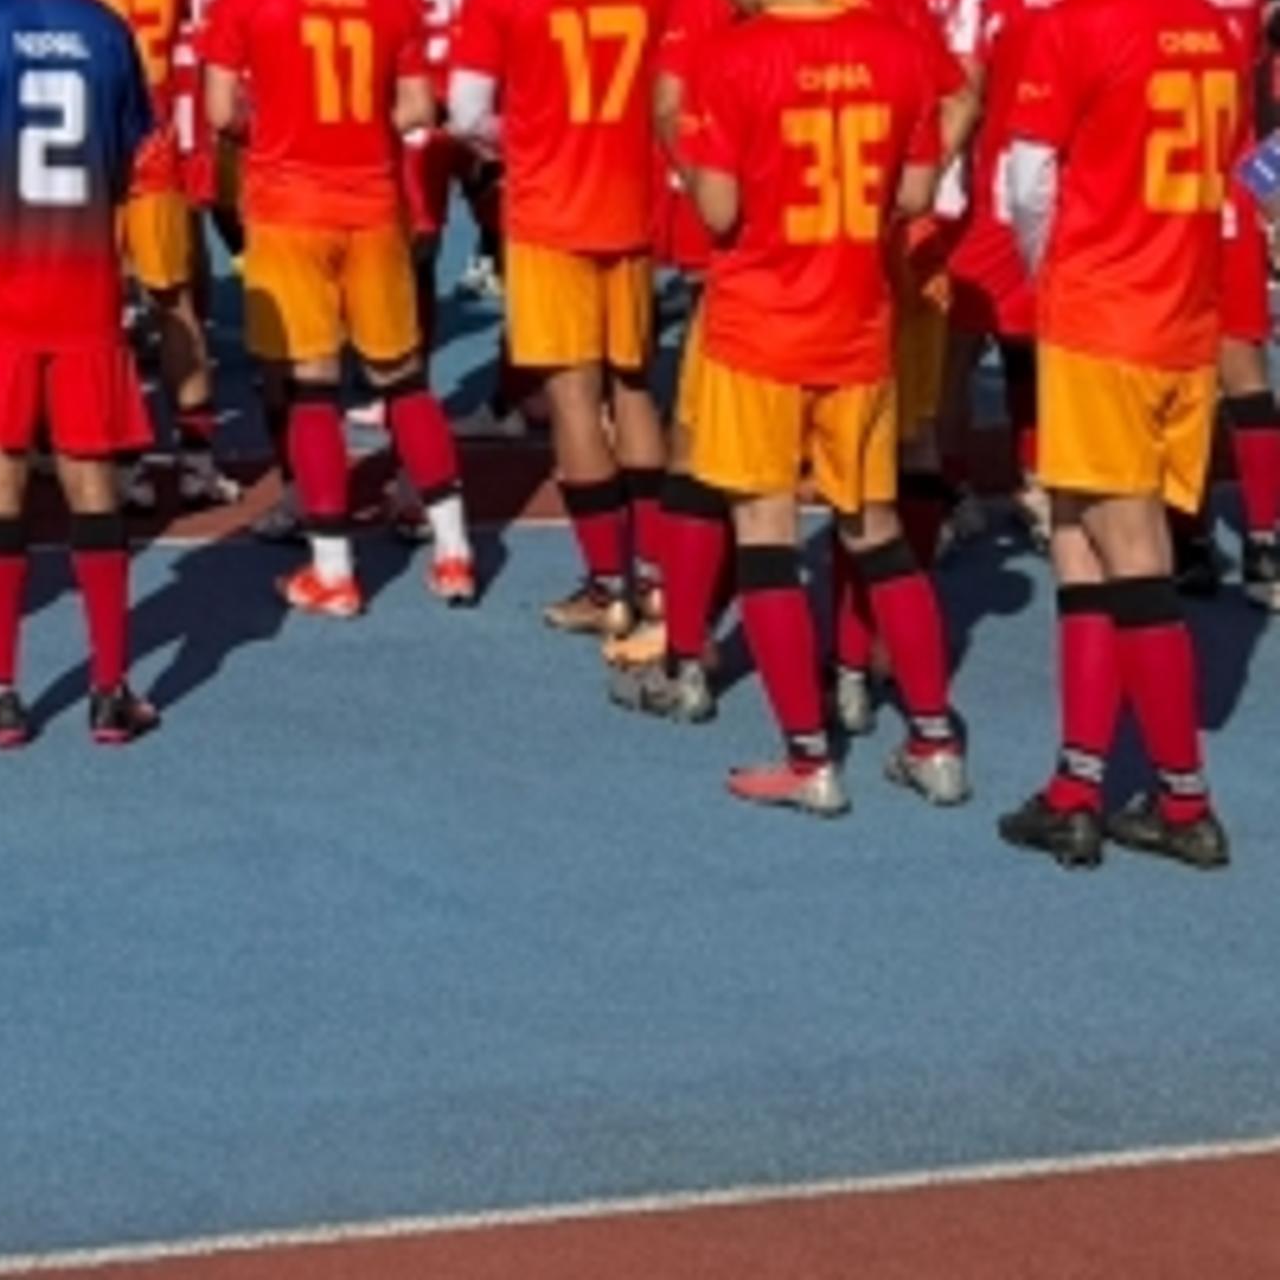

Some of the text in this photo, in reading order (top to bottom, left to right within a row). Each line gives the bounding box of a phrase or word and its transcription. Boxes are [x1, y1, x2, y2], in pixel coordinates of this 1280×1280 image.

[301, 15, 373, 124] 11
[549, 5, 648, 124] 17
[19, 70, 88, 205] 2
